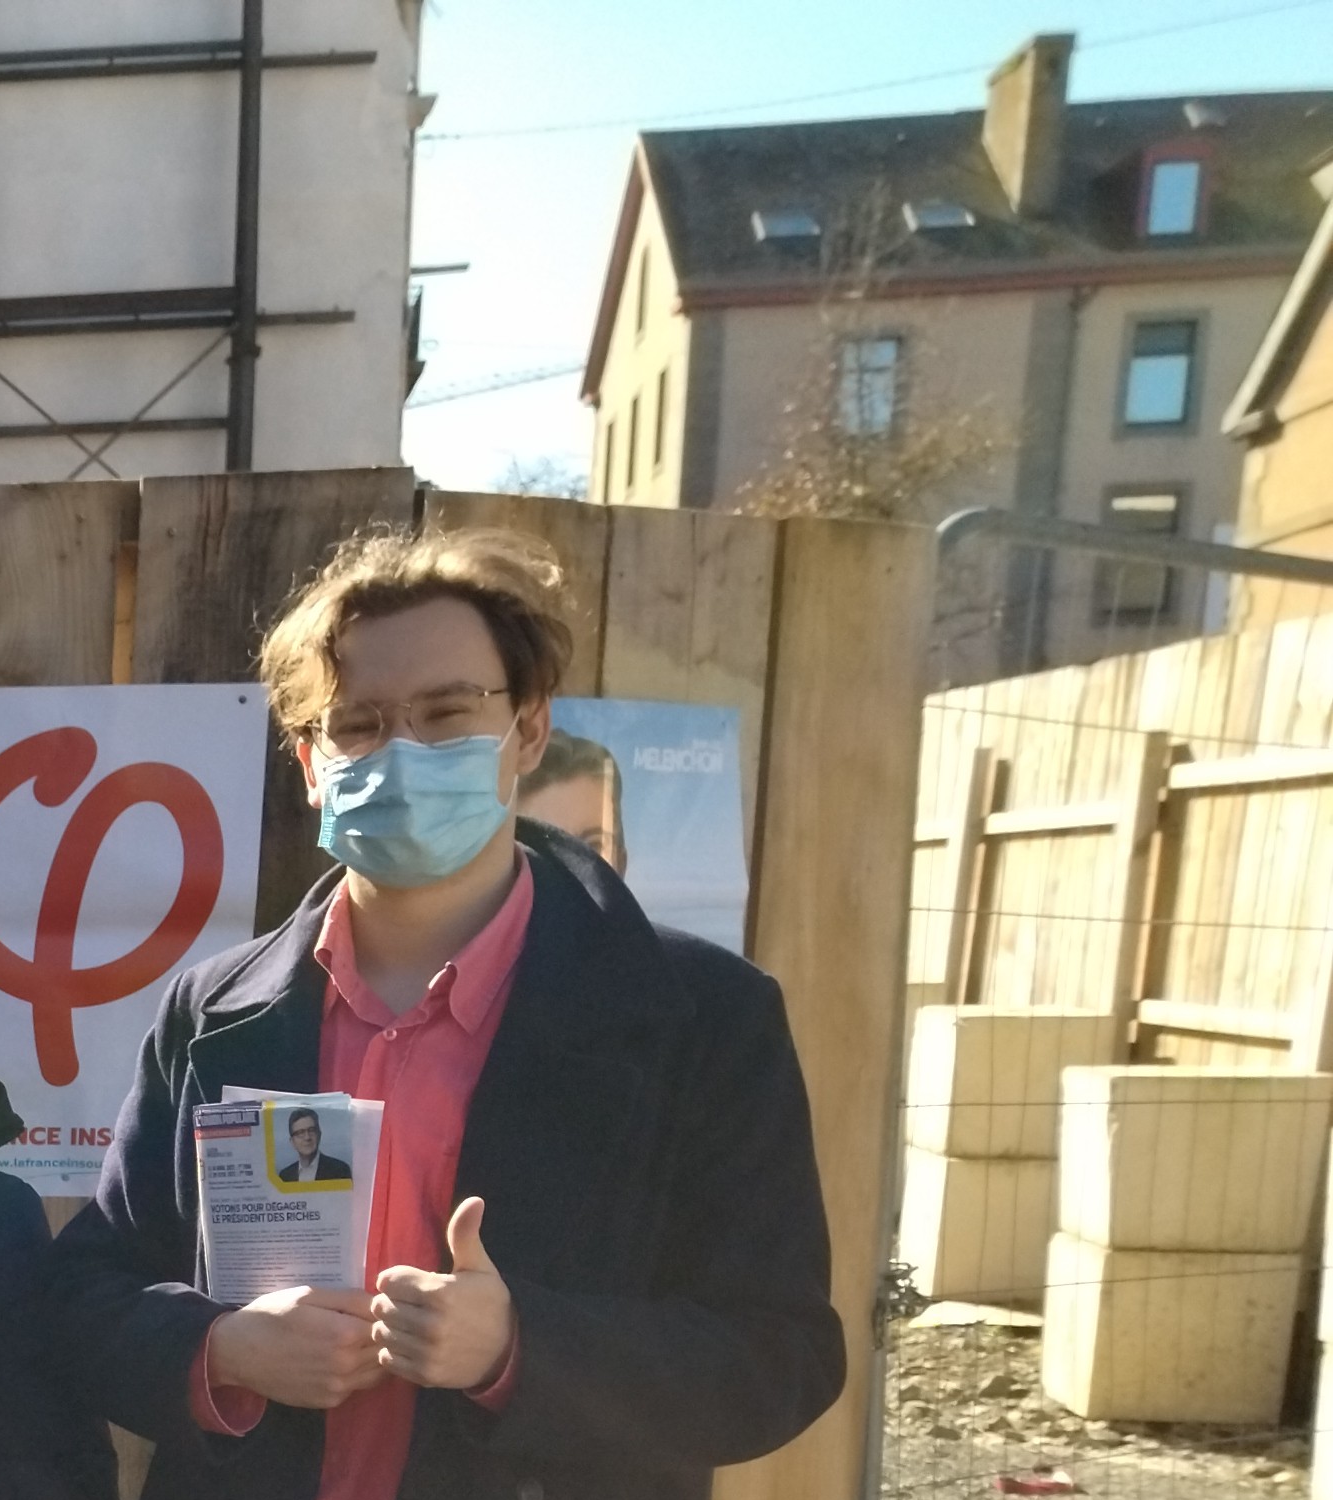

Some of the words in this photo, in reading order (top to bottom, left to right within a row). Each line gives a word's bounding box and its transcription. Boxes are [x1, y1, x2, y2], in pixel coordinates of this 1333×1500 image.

[70, 1127, 115, 1147] INS
[242, 1202, 264, 1213] POUR
[212, 1214, 221, 1224] LE
[267, 1211, 285, 1222] DES
[286, 1210, 321, 1222] RICHES
